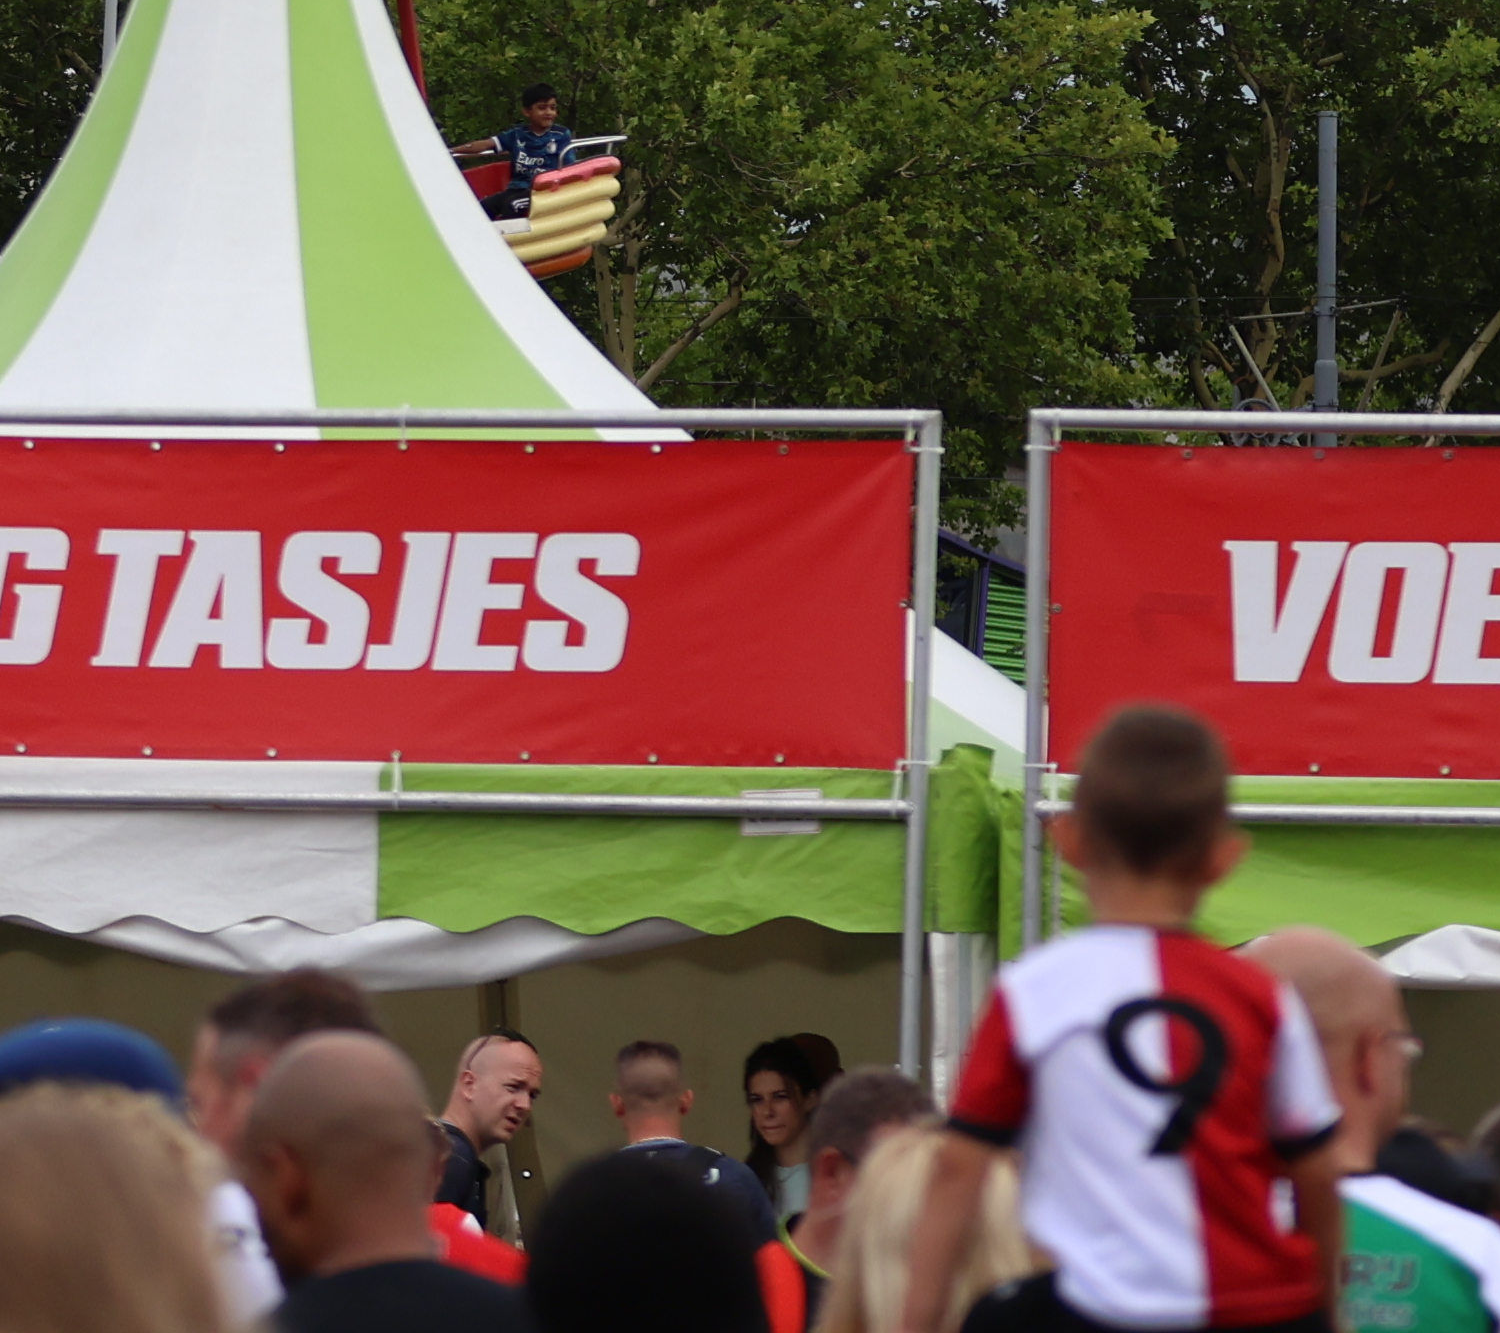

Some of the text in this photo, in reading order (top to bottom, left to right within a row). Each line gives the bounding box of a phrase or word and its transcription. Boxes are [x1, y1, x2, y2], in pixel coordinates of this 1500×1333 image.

[517, 151, 545, 166] Euro
[89, 527, 641, 674] TASJES
[1105, 996, 1227, 1155] 9
